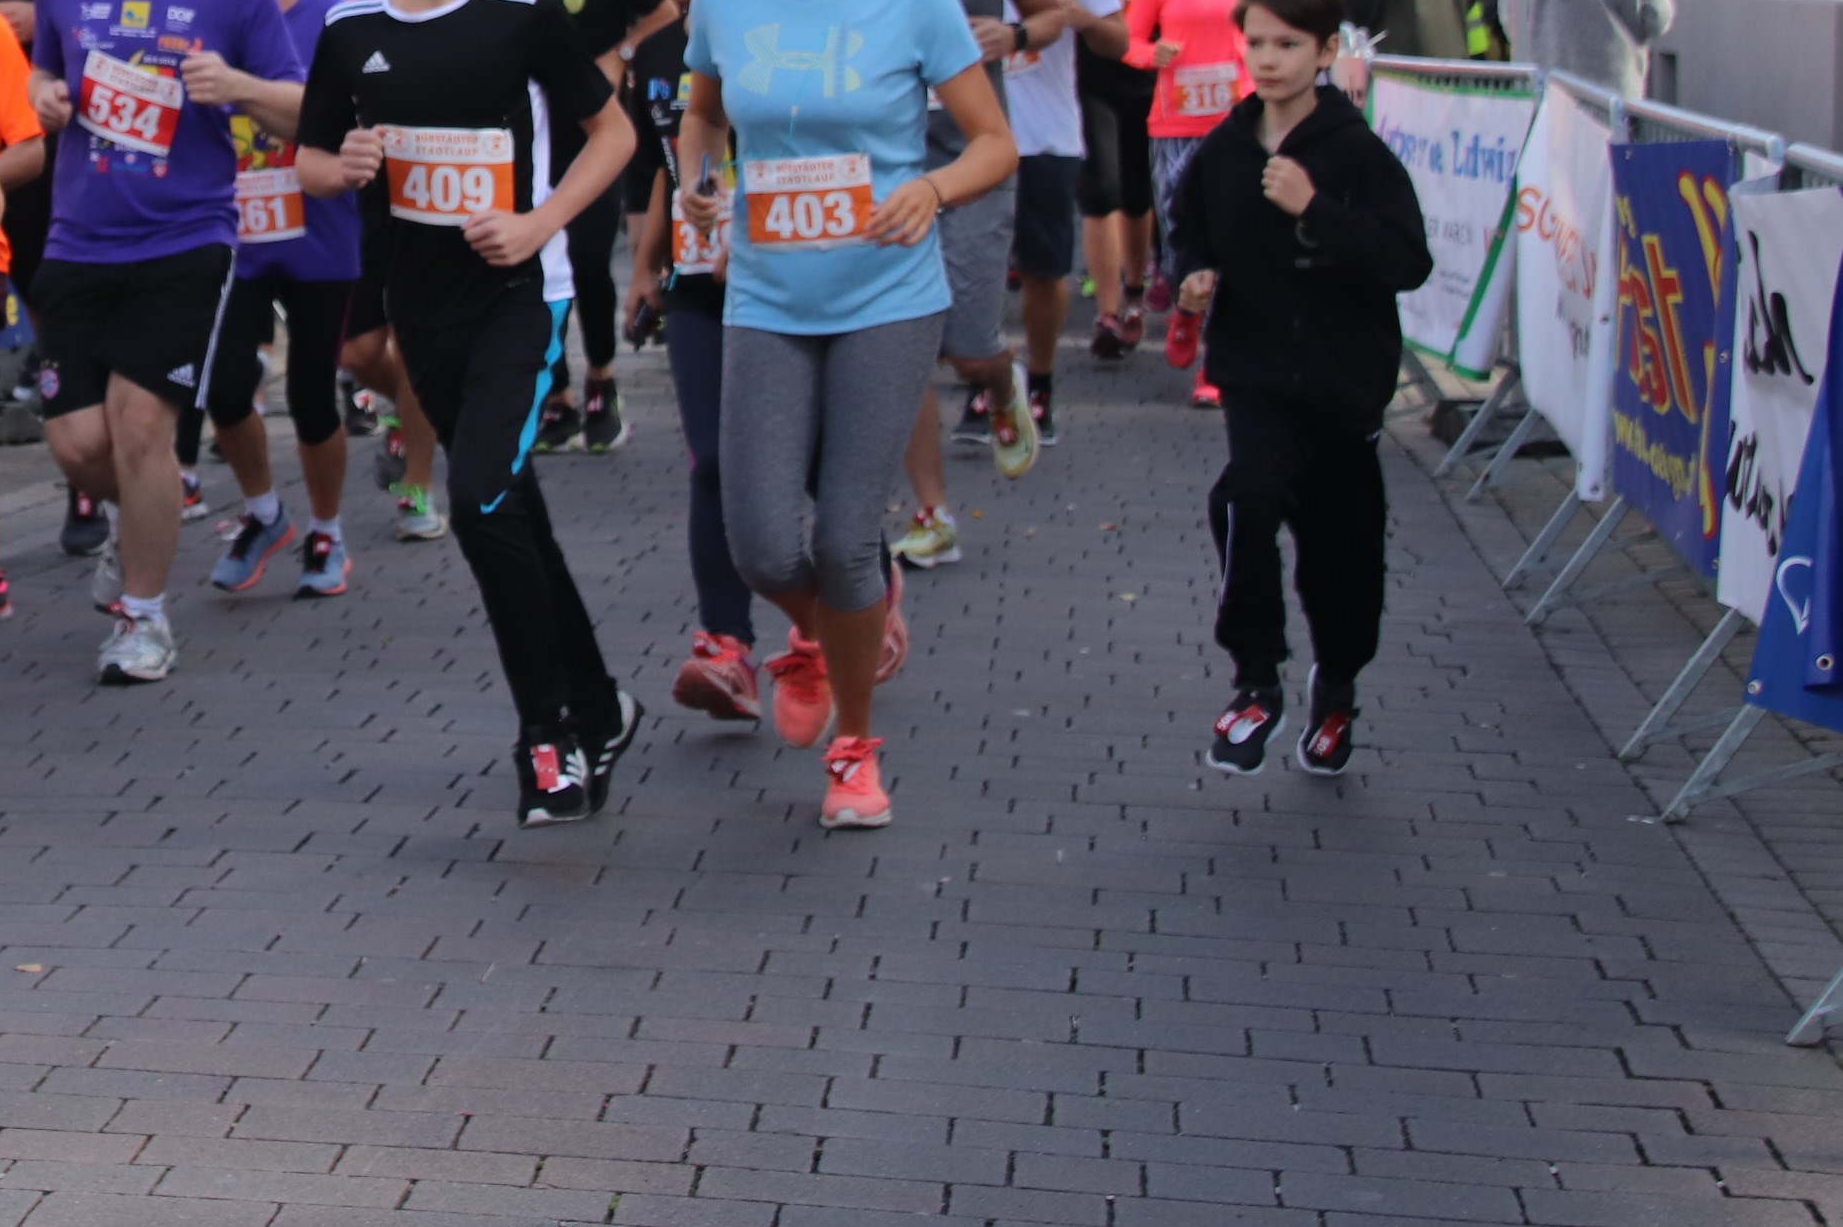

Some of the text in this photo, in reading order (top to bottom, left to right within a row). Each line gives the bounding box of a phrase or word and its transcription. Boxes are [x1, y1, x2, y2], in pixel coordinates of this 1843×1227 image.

[87, 83, 163, 143] 534
[402, 165, 494, 213] 409
[764, 191, 855, 239] 403
